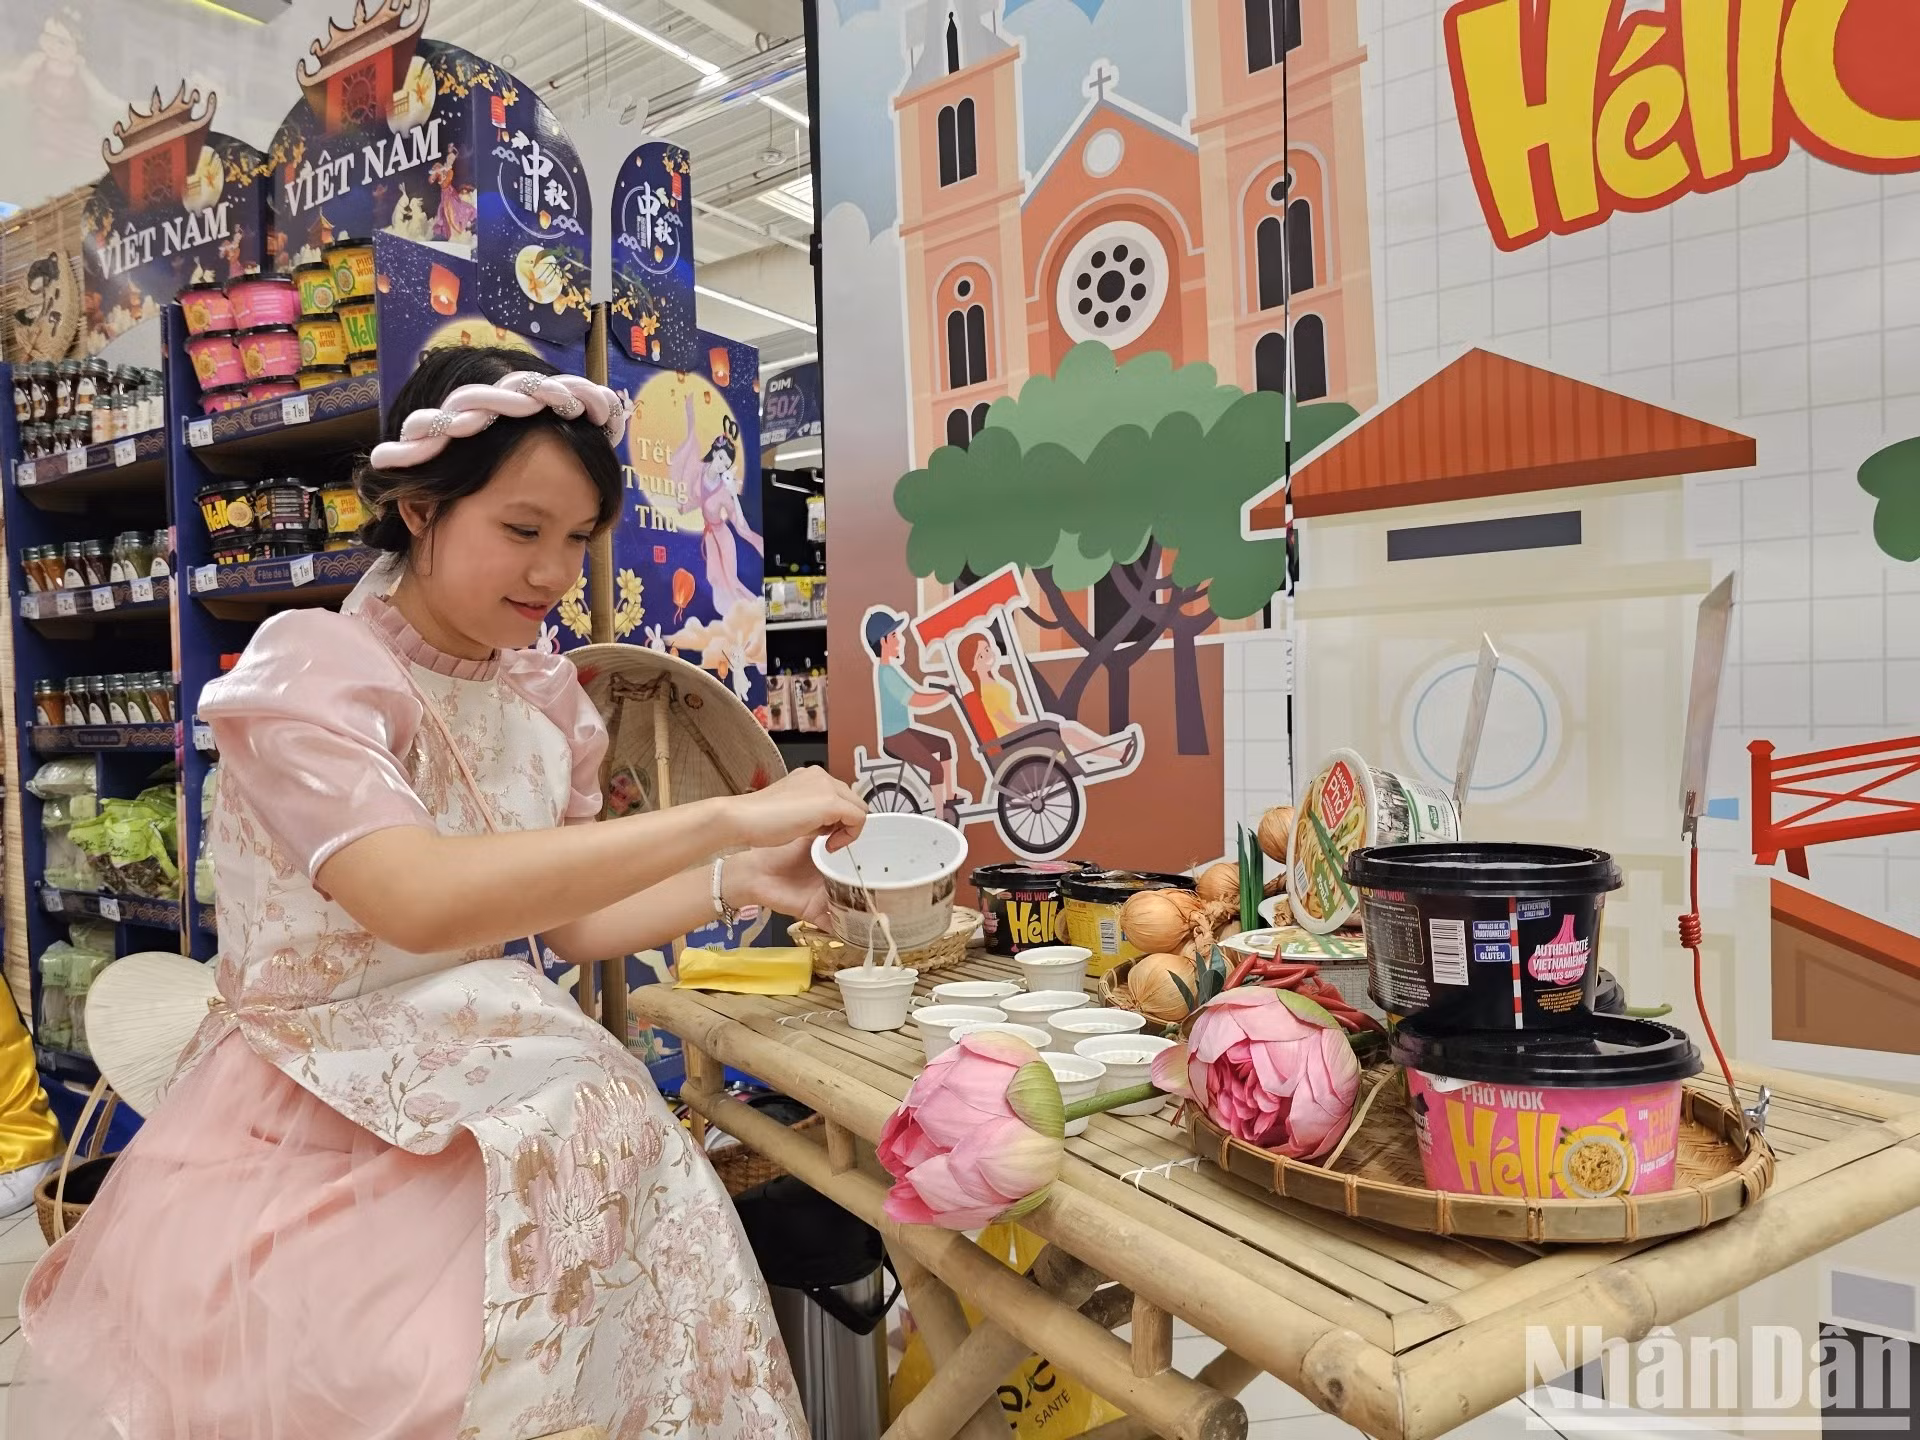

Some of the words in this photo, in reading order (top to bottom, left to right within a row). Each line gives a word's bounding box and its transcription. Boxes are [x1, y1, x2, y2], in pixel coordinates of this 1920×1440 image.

[361, 117, 442, 186] NAM
[162, 201, 230, 257] NAM
[769, 377, 791, 393] DIM
[622, 464, 689, 505] Trung
[635, 504, 679, 533] Thu
[257, 569, 275, 580] Fête
[276, 569, 285, 579] de
[1335, 766, 1352, 801] SAIGON
[1387, 890, 1406, 902] WOK
[1479, 951, 1506, 960] GLUTEN
[1534, 936, 1589, 957] AUTHENTICITÉ
[1532, 952, 1588, 971] VIETNAMIENNE
[1537, 970, 1564, 982] NOUILLES
[1500, 1089, 1545, 1111] WOK
[1638, 1109, 1649, 1121] UN
